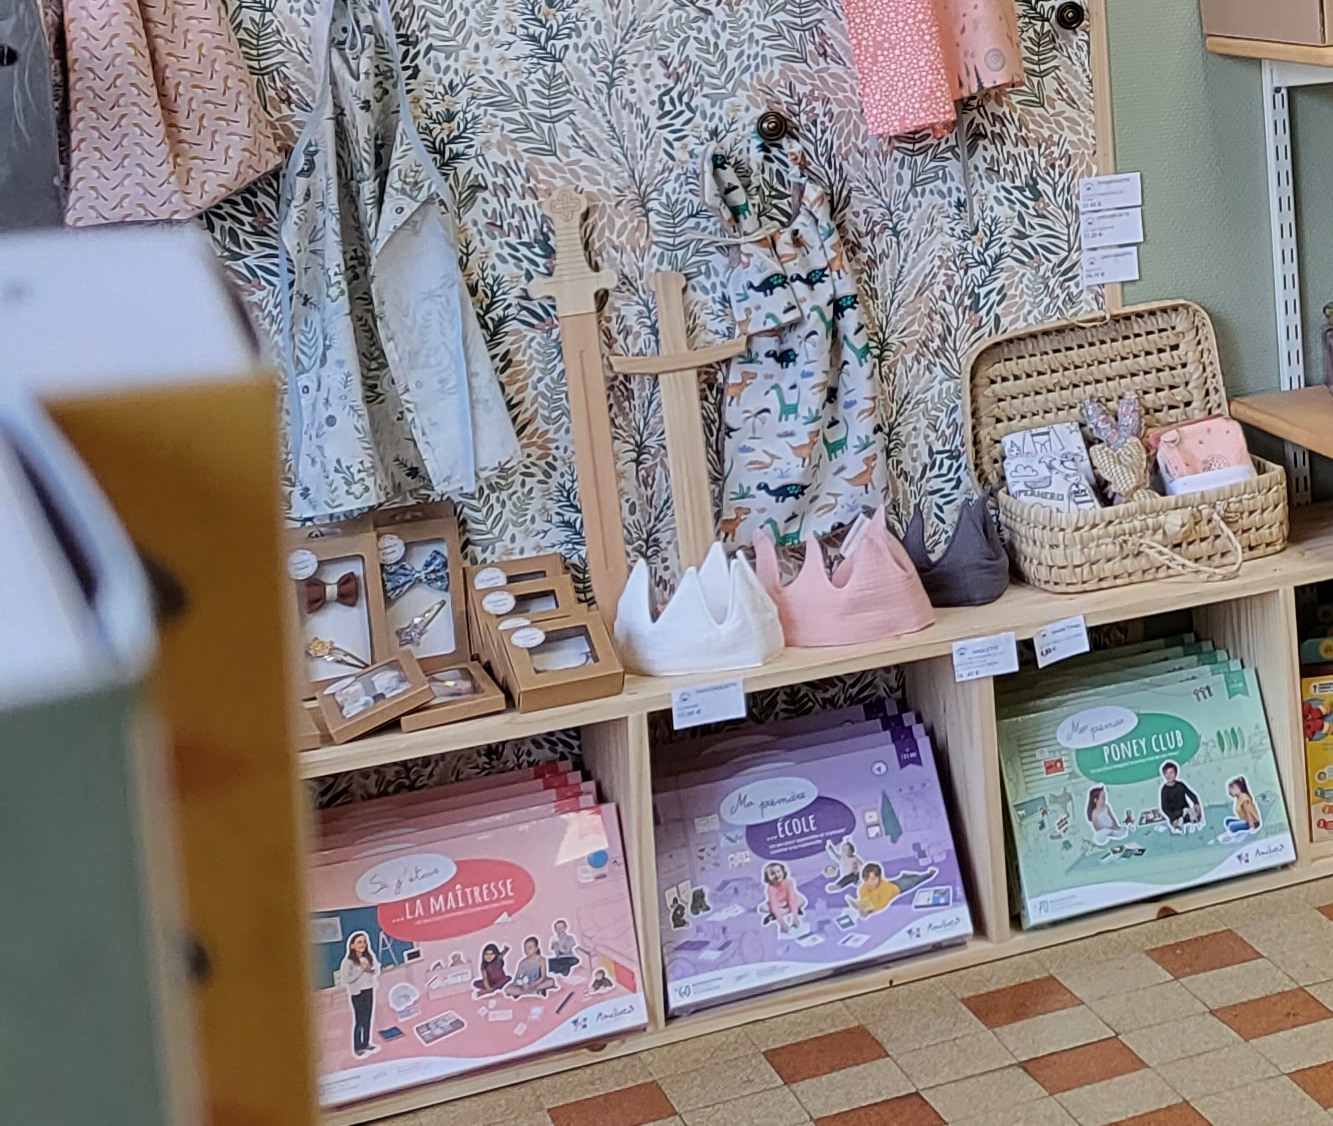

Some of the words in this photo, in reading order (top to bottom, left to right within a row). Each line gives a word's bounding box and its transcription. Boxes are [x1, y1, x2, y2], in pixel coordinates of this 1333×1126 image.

[1103, 742, 1147, 764] PONEY
[1151, 730, 1184, 753] CLUB
[429, 878, 514, 913] MAÎTRESSE
